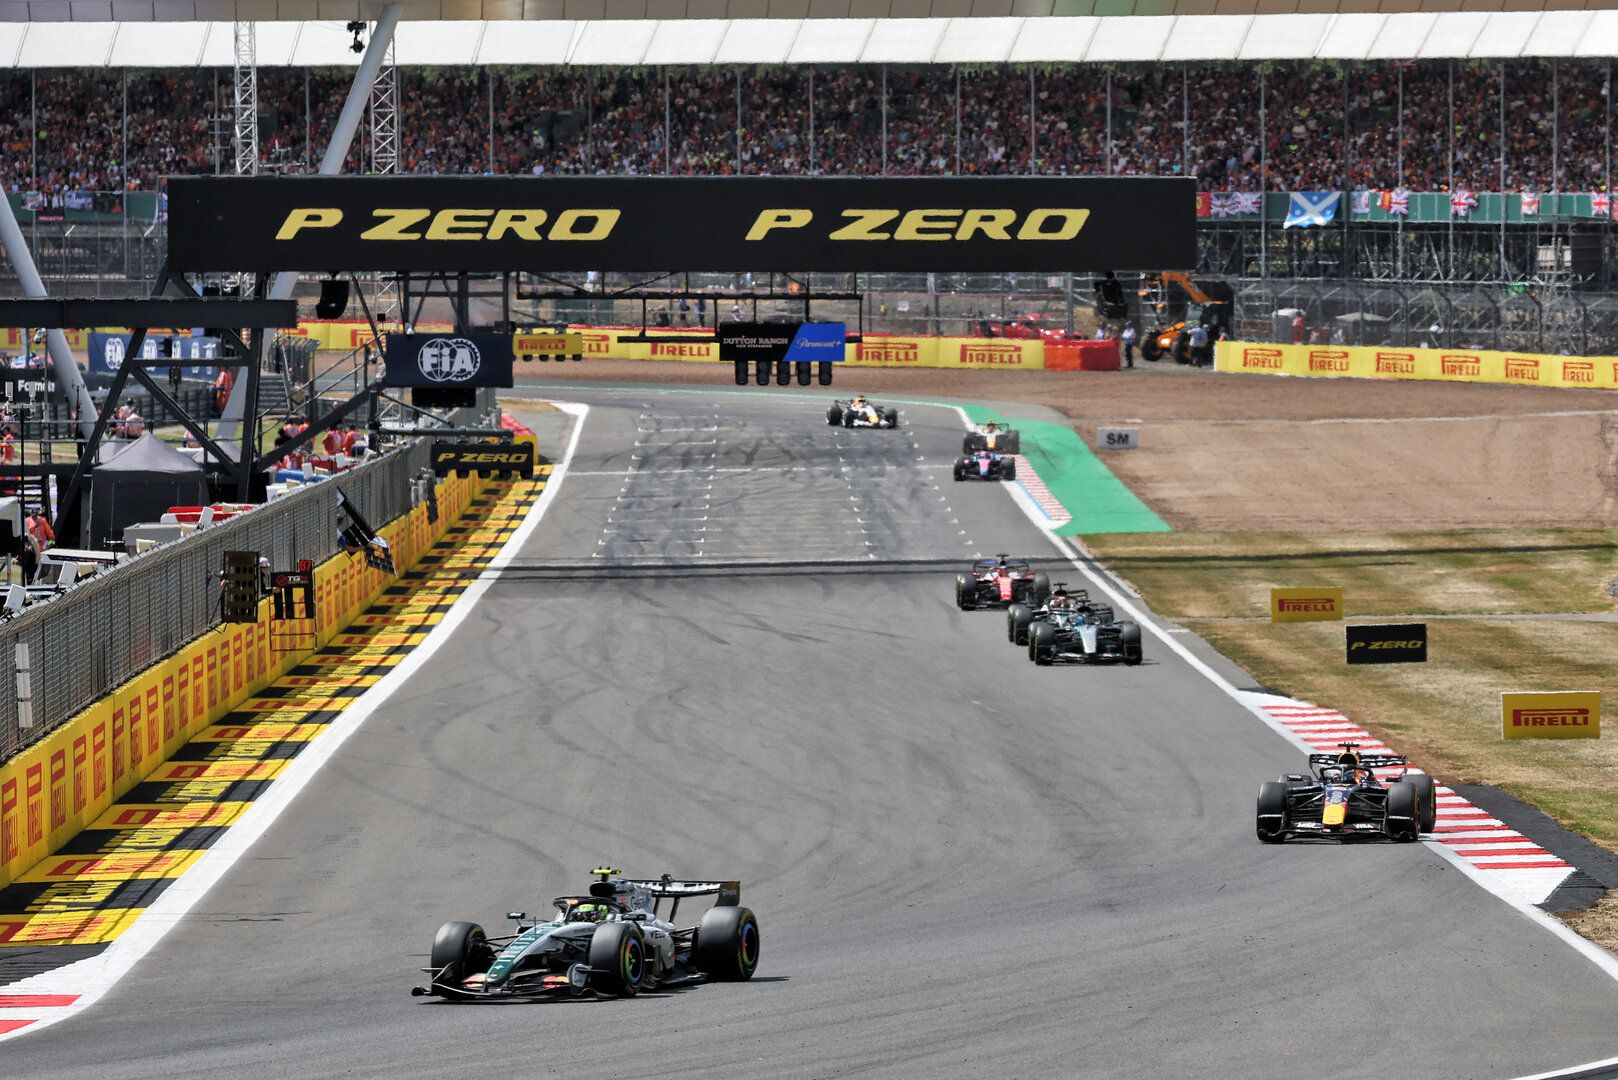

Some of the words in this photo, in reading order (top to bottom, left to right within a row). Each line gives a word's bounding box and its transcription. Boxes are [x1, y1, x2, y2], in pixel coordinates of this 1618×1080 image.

[275, 208, 343, 240] P
[360, 208, 621, 240] ZERO
[745, 208, 813, 240] P
[829, 208, 1091, 240] ZERO
[518, 338, 566, 351] PIRELLI
[723, 335, 757, 345] DUTTON
[856, 341, 918, 362] PIRELLI
[960, 343, 1022, 365] PIRELLI
[1243, 348, 1283, 369] PIRELLI
[1309, 350, 1349, 372] PIRELLI
[1376, 352, 1415, 374] PIRELLI
[1441, 354, 1481, 377] PIRELLI
[1505, 357, 1540, 381] PIRELLI
[1562, 361, 1595, 383] PIRELLI
[1106, 432, 1130, 445] SM
[437, 453, 456, 463] P
[458, 453, 529, 464] ZERO
[300, 560, 312, 571] 87
[1278, 598, 1336, 612] PIRELLI
[1351, 642, 1366, 650] P
[1367, 640, 1424, 650] ZERO
[1512, 708, 1590, 727] PIRELLI
